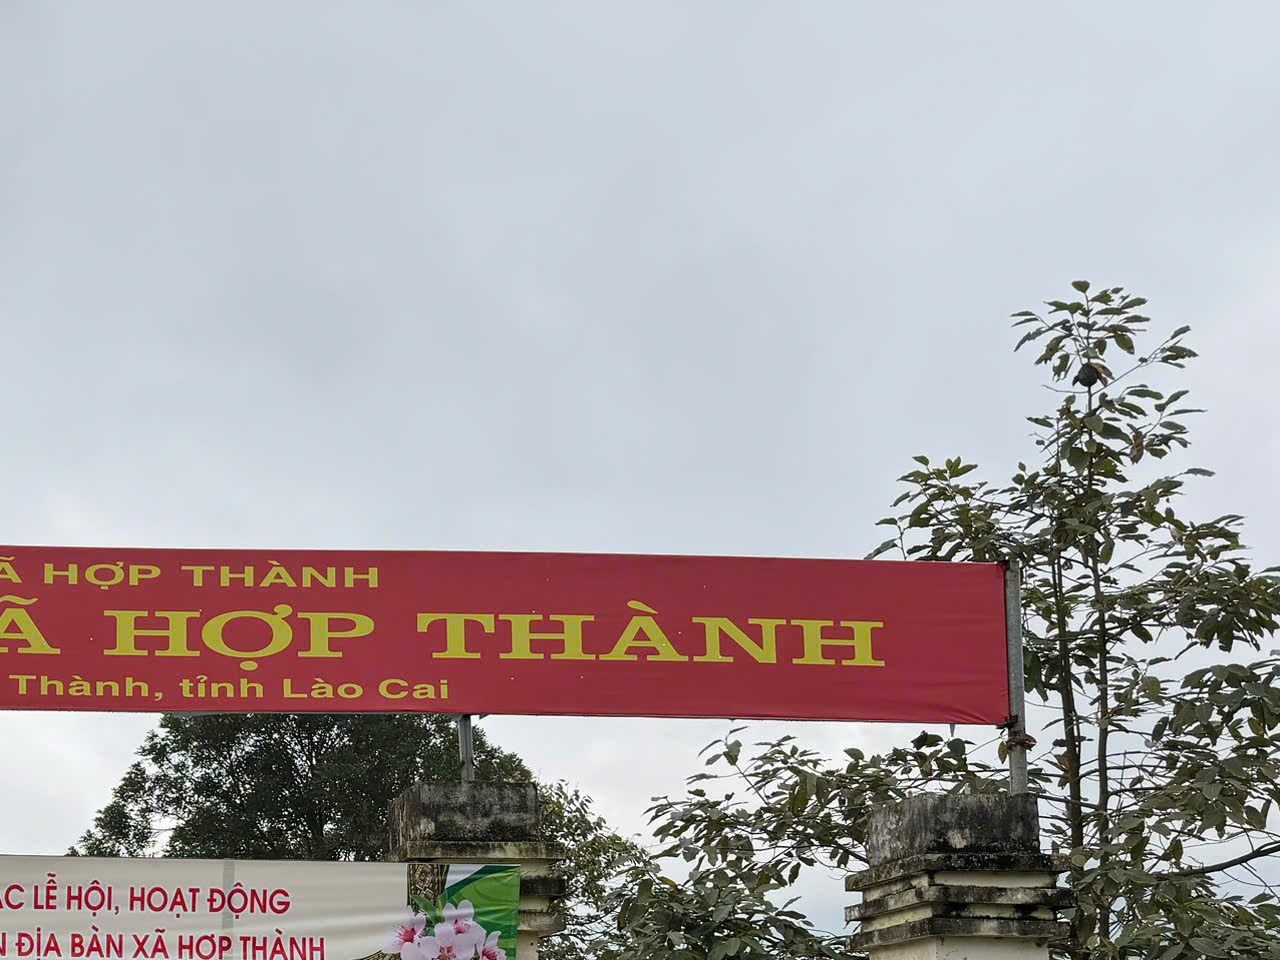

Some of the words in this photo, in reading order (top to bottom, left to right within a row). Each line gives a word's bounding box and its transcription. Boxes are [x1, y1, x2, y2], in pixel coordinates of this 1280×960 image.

[44, 561, 161, 589] HỢP
[183, 561, 379, 589] THÀNH
[102, 604, 376, 672] HỢP
[416, 600, 886, 667] THÀNH
[10, 673, 163, 700] Thành,
[180, 674, 264, 699] tỉnh
[283, 677, 364, 700] Lào
[378, 679, 449, 700] Cai
[33, 873, 58, 911] LỄ
[66, 880, 120, 917] HỘI,
[129, 887, 201, 919] HOẠT
[207, 883, 291, 919] ĐỘNG
[71, 925, 124, 959] BÀN
[133, 928, 170, 960] XÃ
[239, 929, 326, 960] THÀNH
